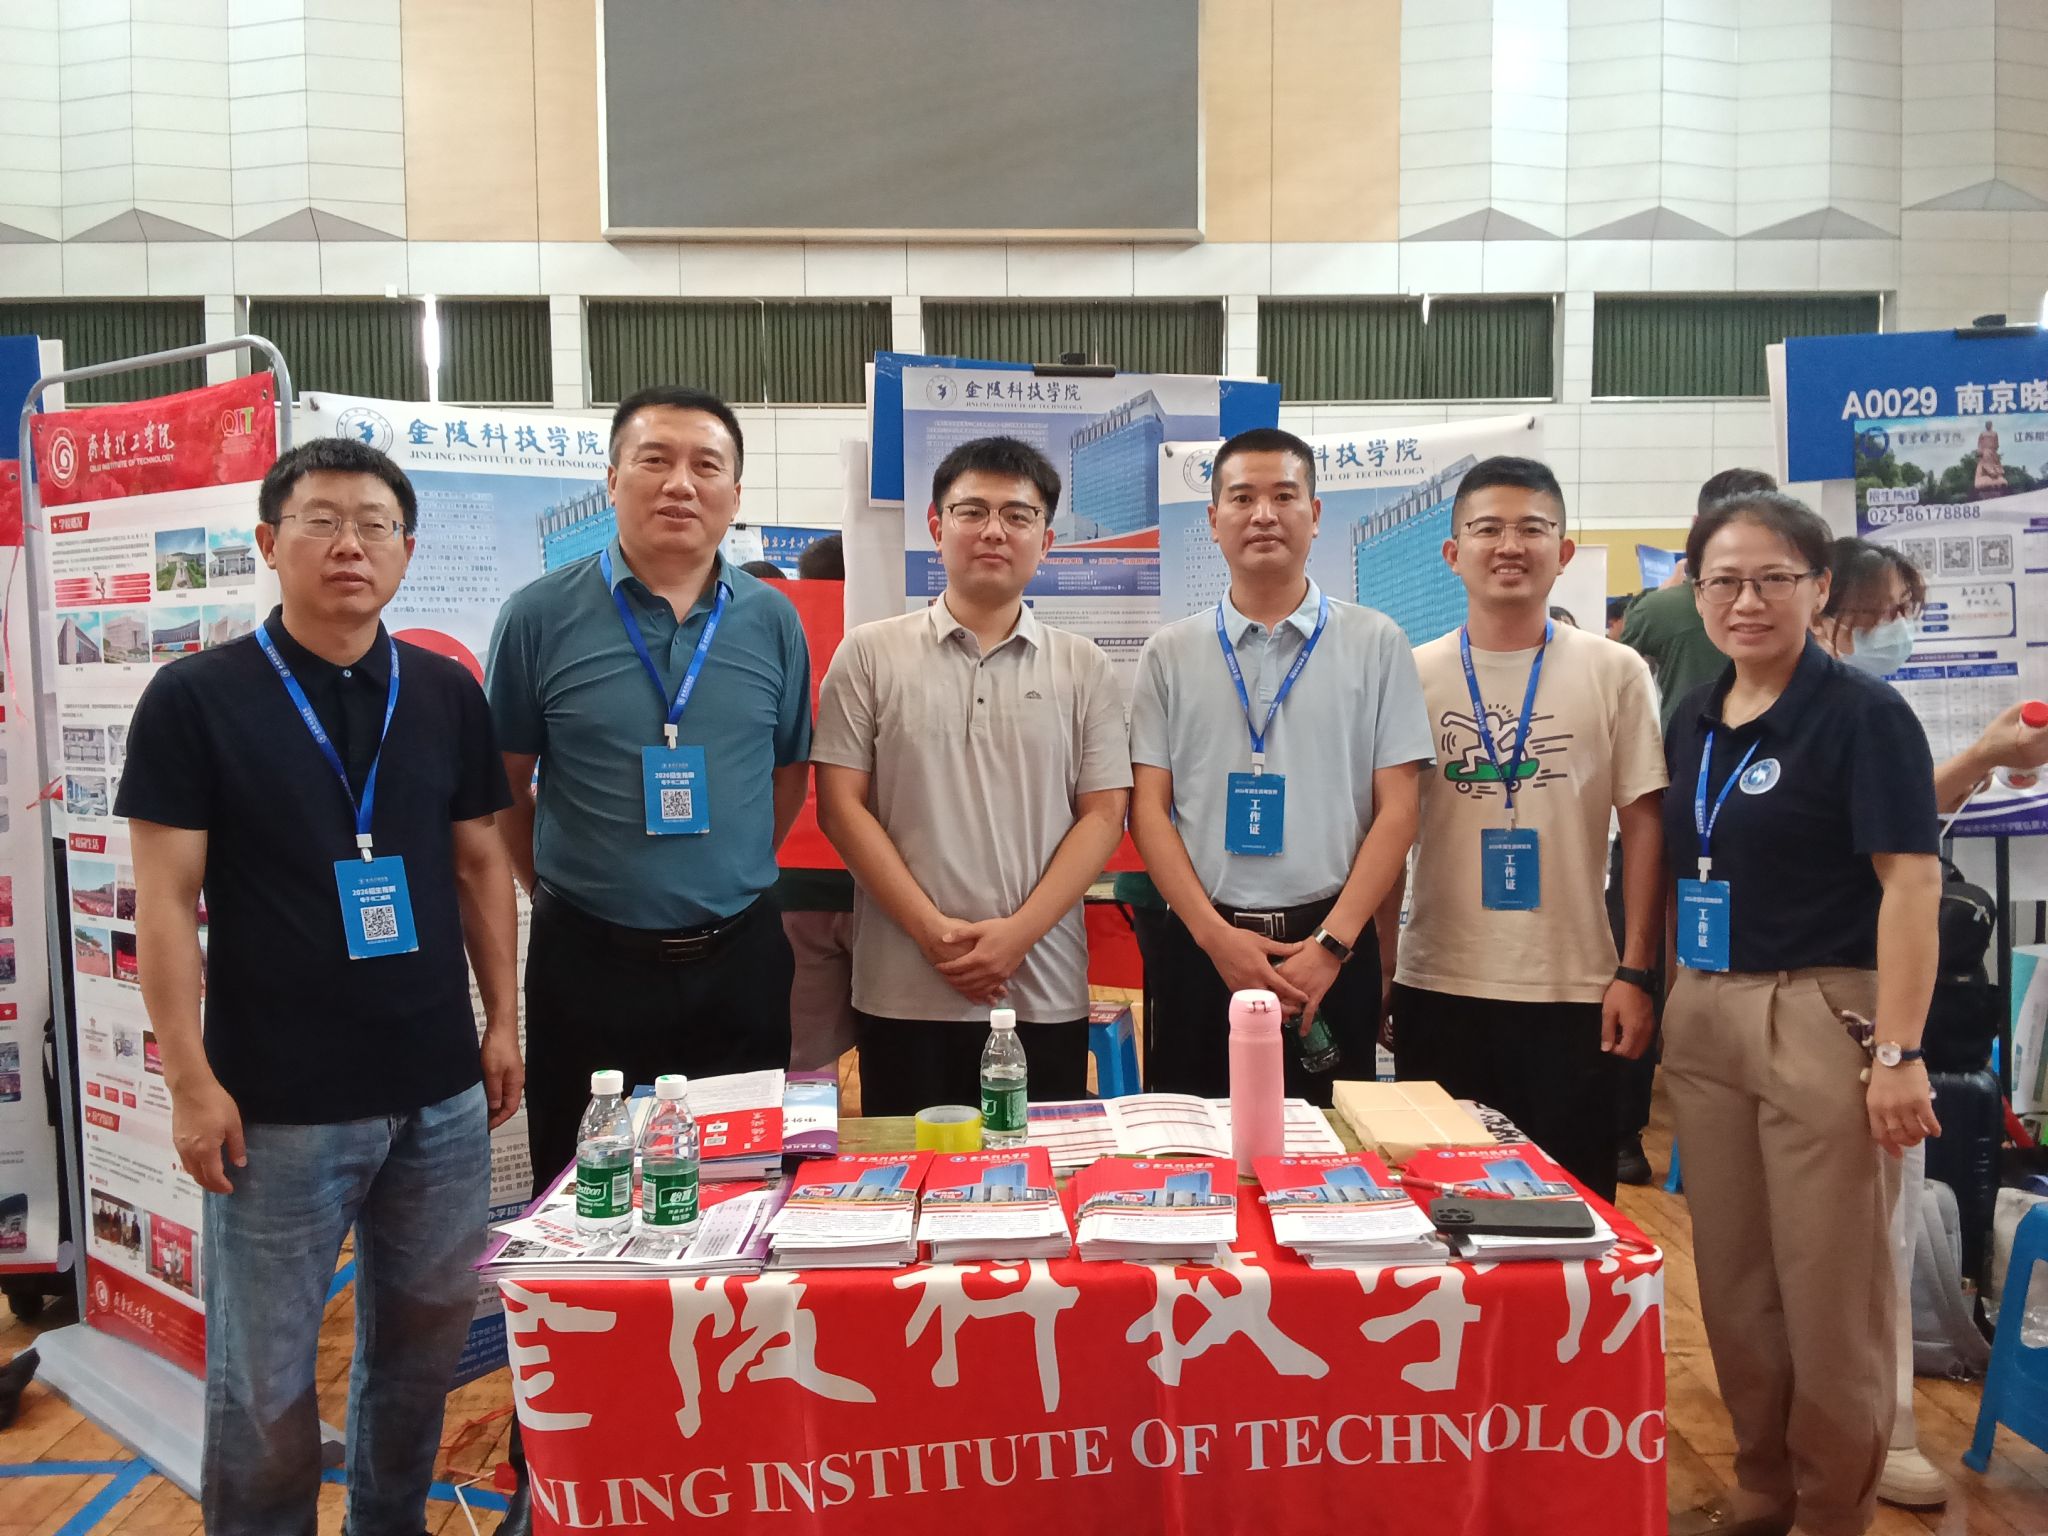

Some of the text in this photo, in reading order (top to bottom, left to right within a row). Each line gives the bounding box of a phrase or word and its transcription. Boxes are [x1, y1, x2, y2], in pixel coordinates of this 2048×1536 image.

[1841, 385, 1938, 420] A0029
[220, 406, 255, 437] QIT
[519, 457, 533, 465] OF
[1868, 506, 1981, 523] 025-86178888
[1249, 799, 1262, 835] 工作证
[747, 1425, 1113, 1514] INSTITUTE
[1131, 1418, 1218, 1476] OF
[1235, 1402, 1665, 1472] TECHNOLOG
